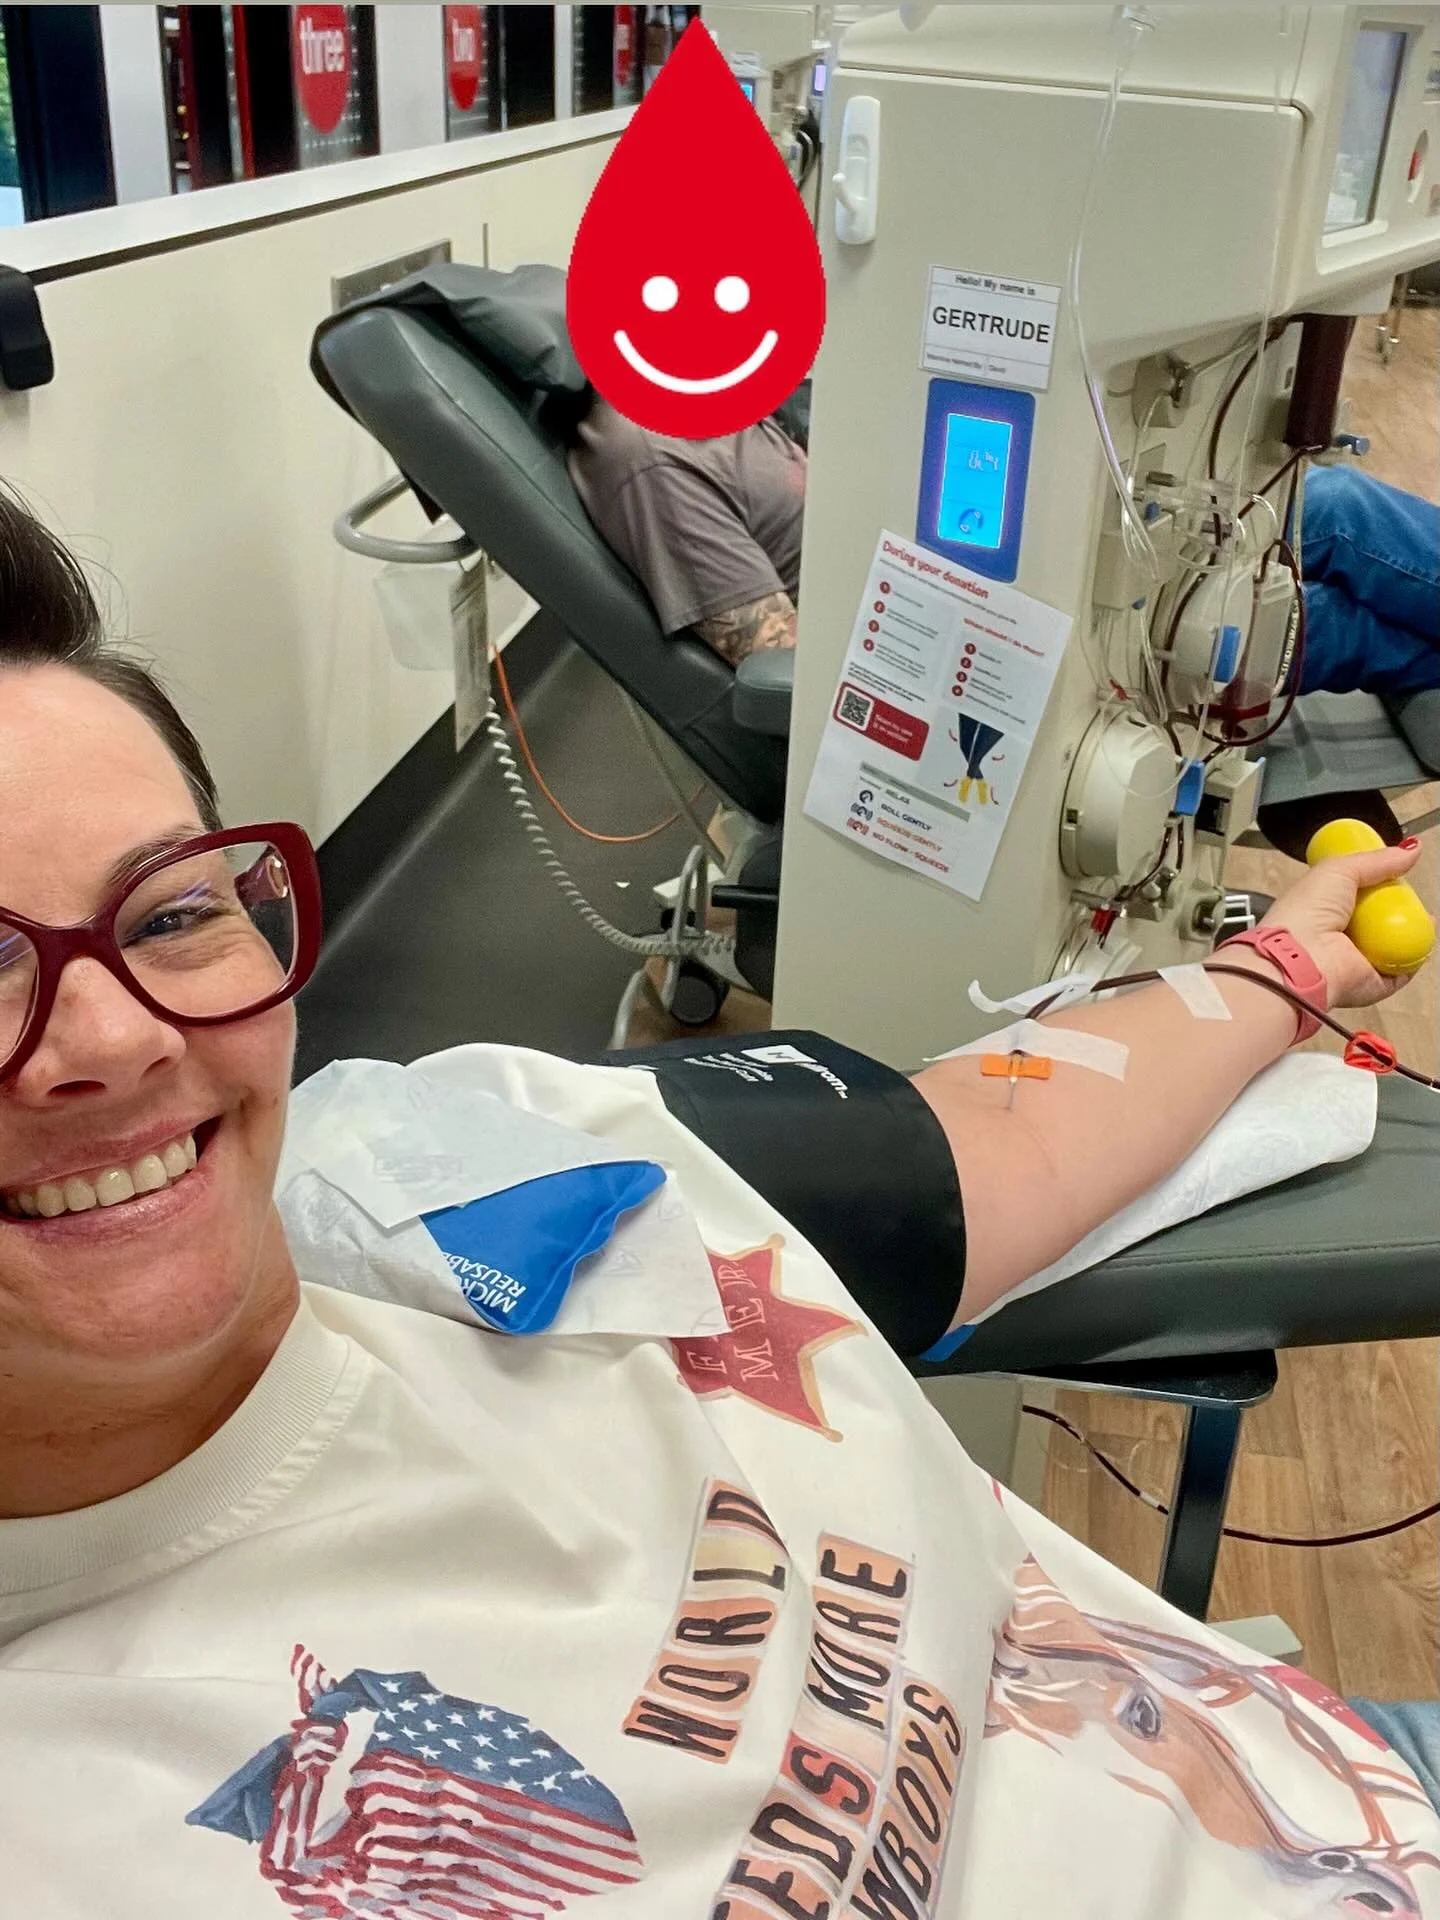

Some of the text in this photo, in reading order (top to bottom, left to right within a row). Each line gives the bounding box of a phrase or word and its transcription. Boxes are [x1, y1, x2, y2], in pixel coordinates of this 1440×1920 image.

[300, 17, 345, 75] three
[955, 274, 1036, 296] Hello! My name is
[932, 306, 1051, 343] GERTRUDE
[882, 540, 917, 568] During
[917, 560, 942, 577] your
[942, 571, 989, 599] donation
[880, 802, 933, 831] ROLL GENTLY
[885, 788, 910, 805] RELAX
[872, 831, 885, 842] NO
[885, 837, 909, 853] FLOW
[914, 851, 949, 873] SQUEEZE
[911, 834, 942, 852] GENTLY
[442, 1251, 527, 1298] REUSAB
[457, 1275, 518, 1314] MICR
[623, 1489, 789, 1758] WORLD
[712, 1548, 907, 1920] EDS MORE
